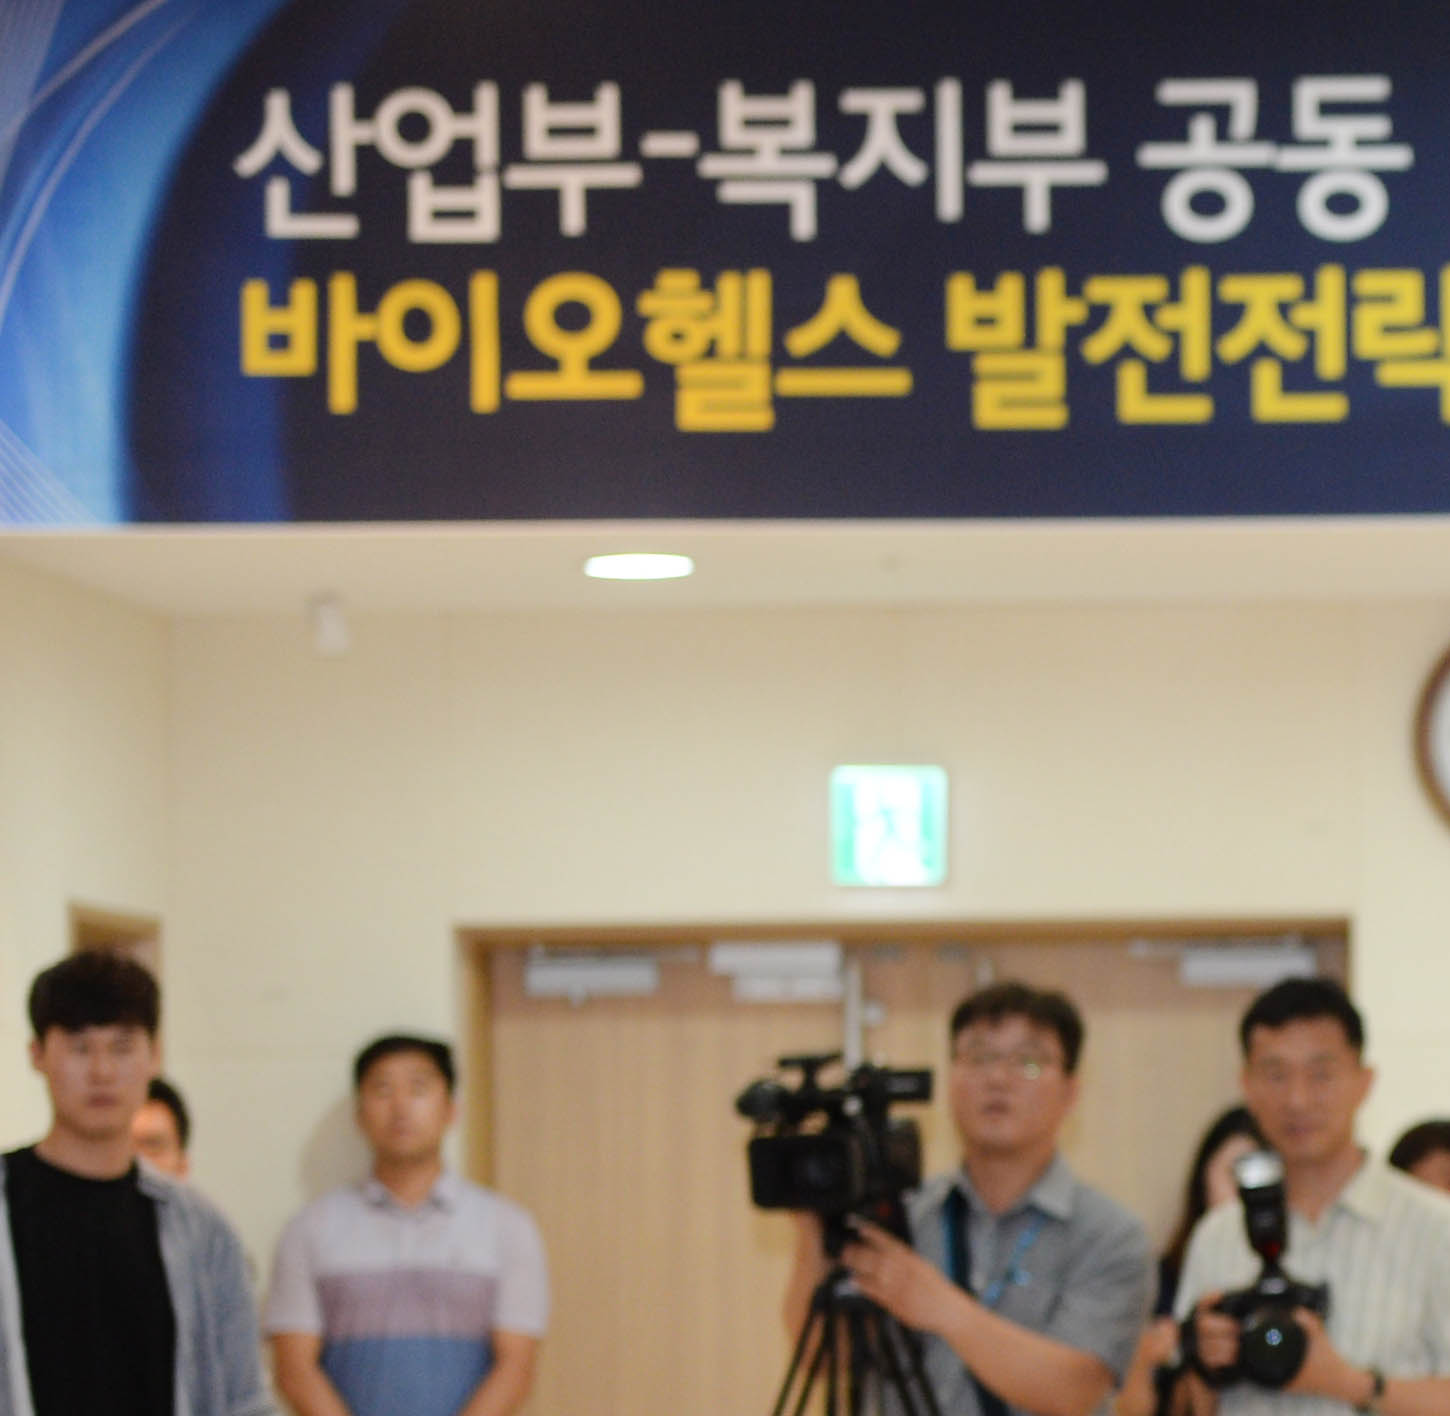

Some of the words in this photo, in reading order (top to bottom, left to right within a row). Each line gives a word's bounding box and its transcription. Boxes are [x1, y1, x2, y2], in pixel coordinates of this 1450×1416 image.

[233, 76, 1109, 246] 산업부-복지부
[1136, 75, 1415, 244] 공동
[239, 267, 914, 434] 바이오헬스
